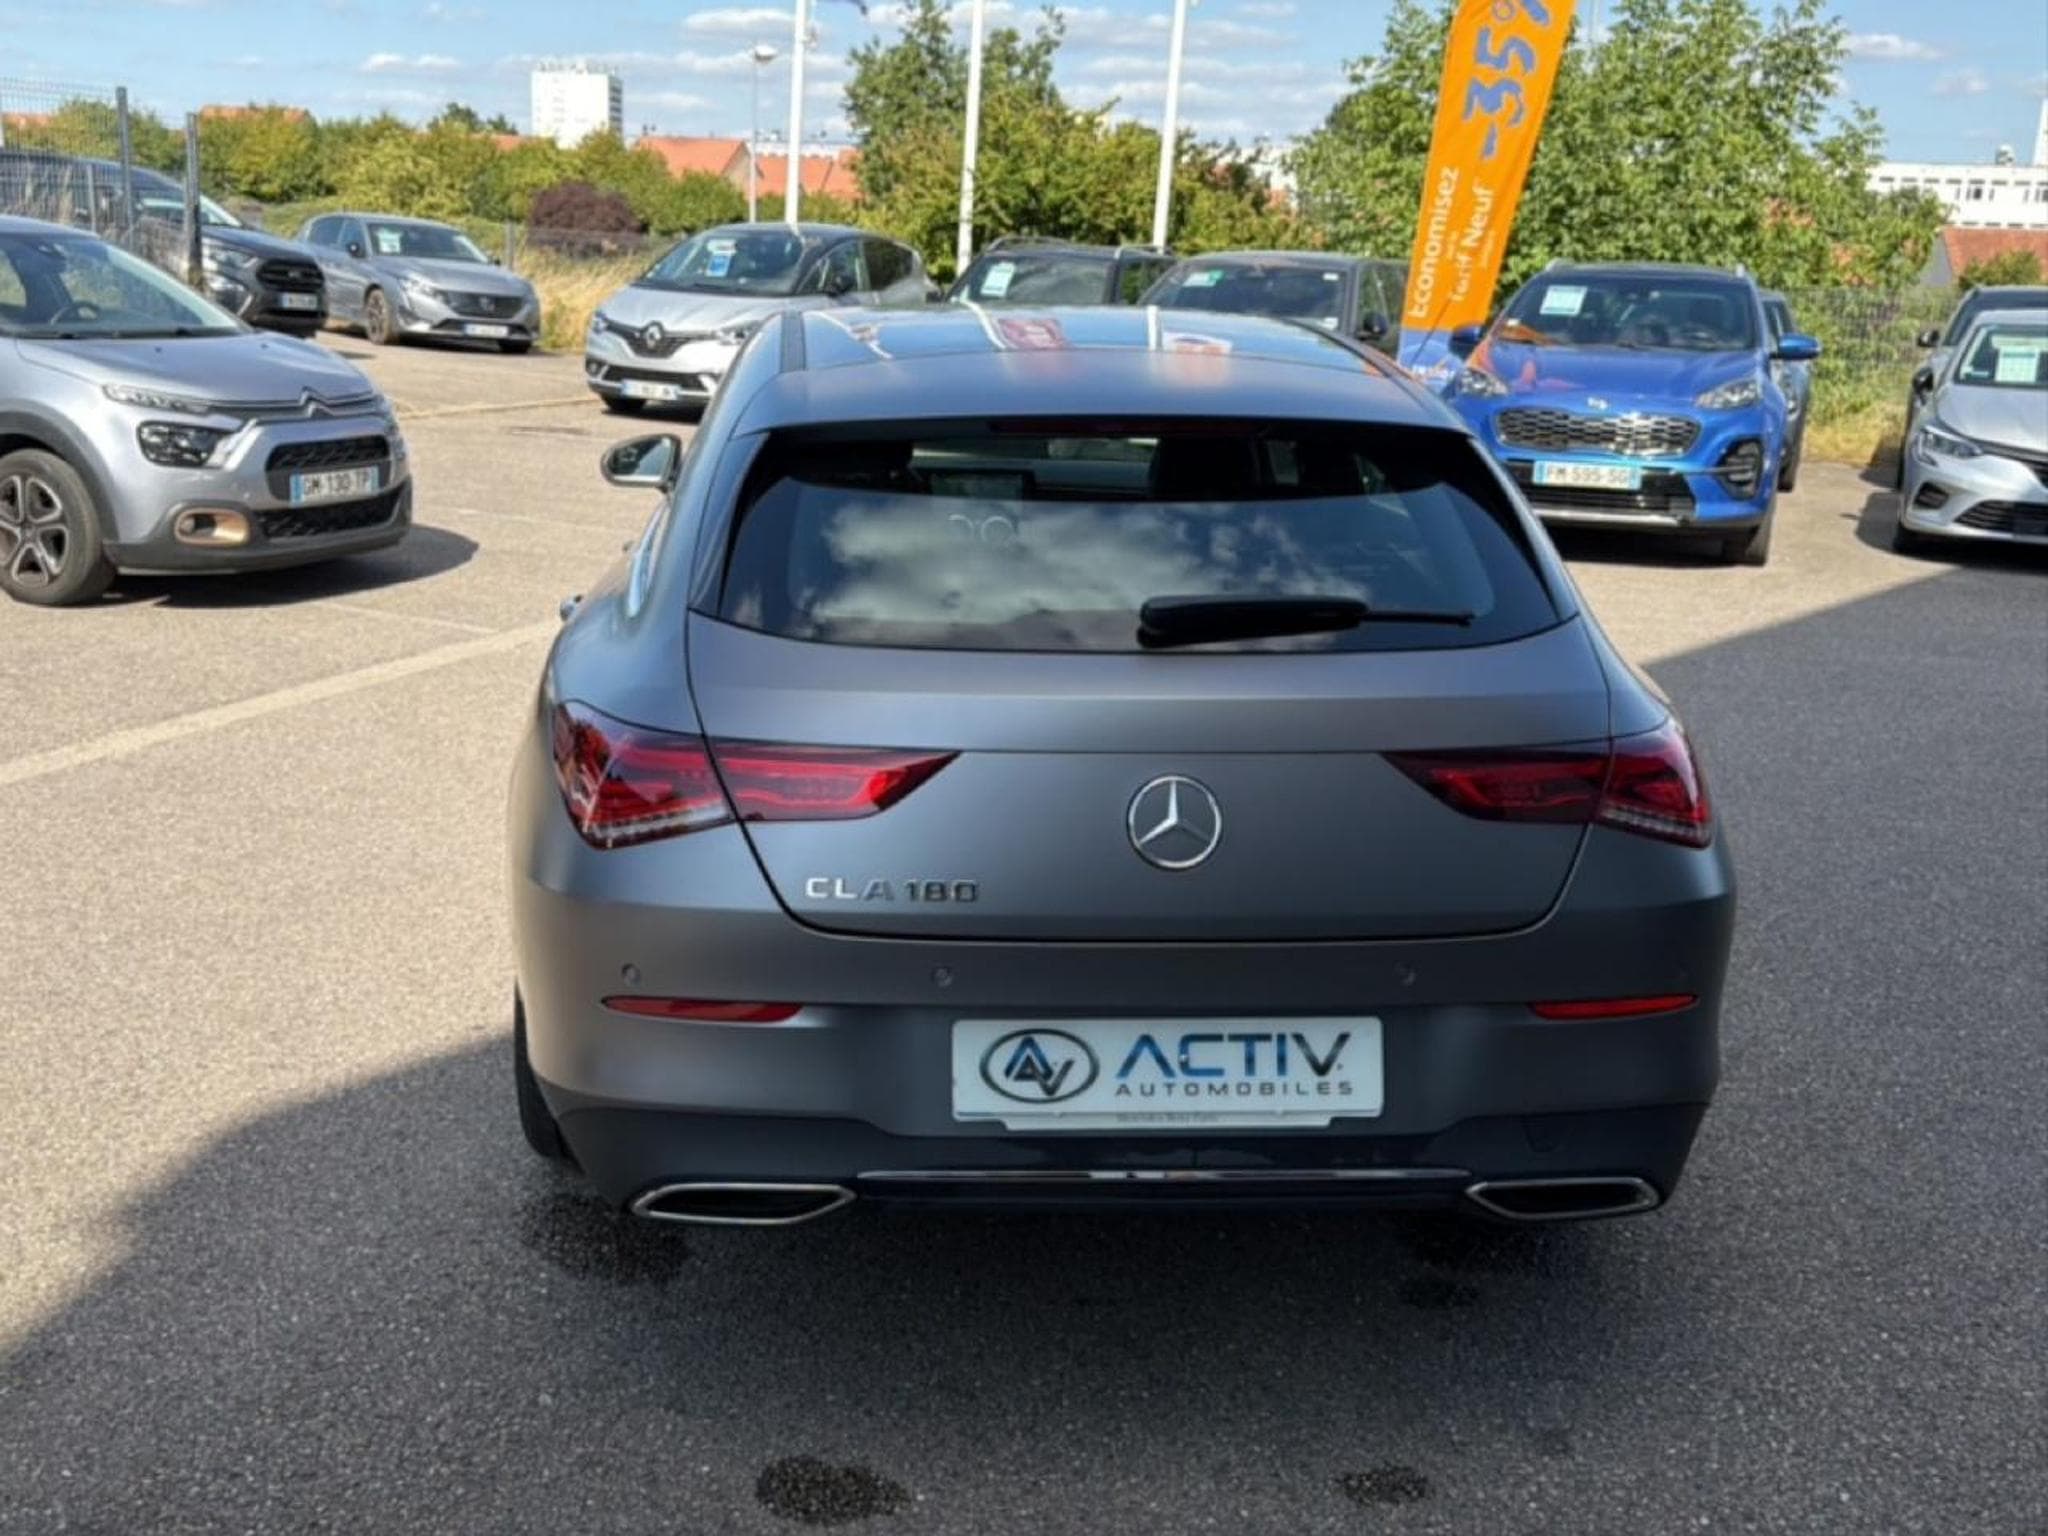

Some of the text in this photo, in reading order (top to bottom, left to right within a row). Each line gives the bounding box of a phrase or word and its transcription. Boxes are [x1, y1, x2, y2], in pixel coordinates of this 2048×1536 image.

[1461, 179, 1494, 247] Neuf
[805, 877, 977, 902] CLA 180
[1116, 1081, 1353, 1097] AUTOMOBILES
